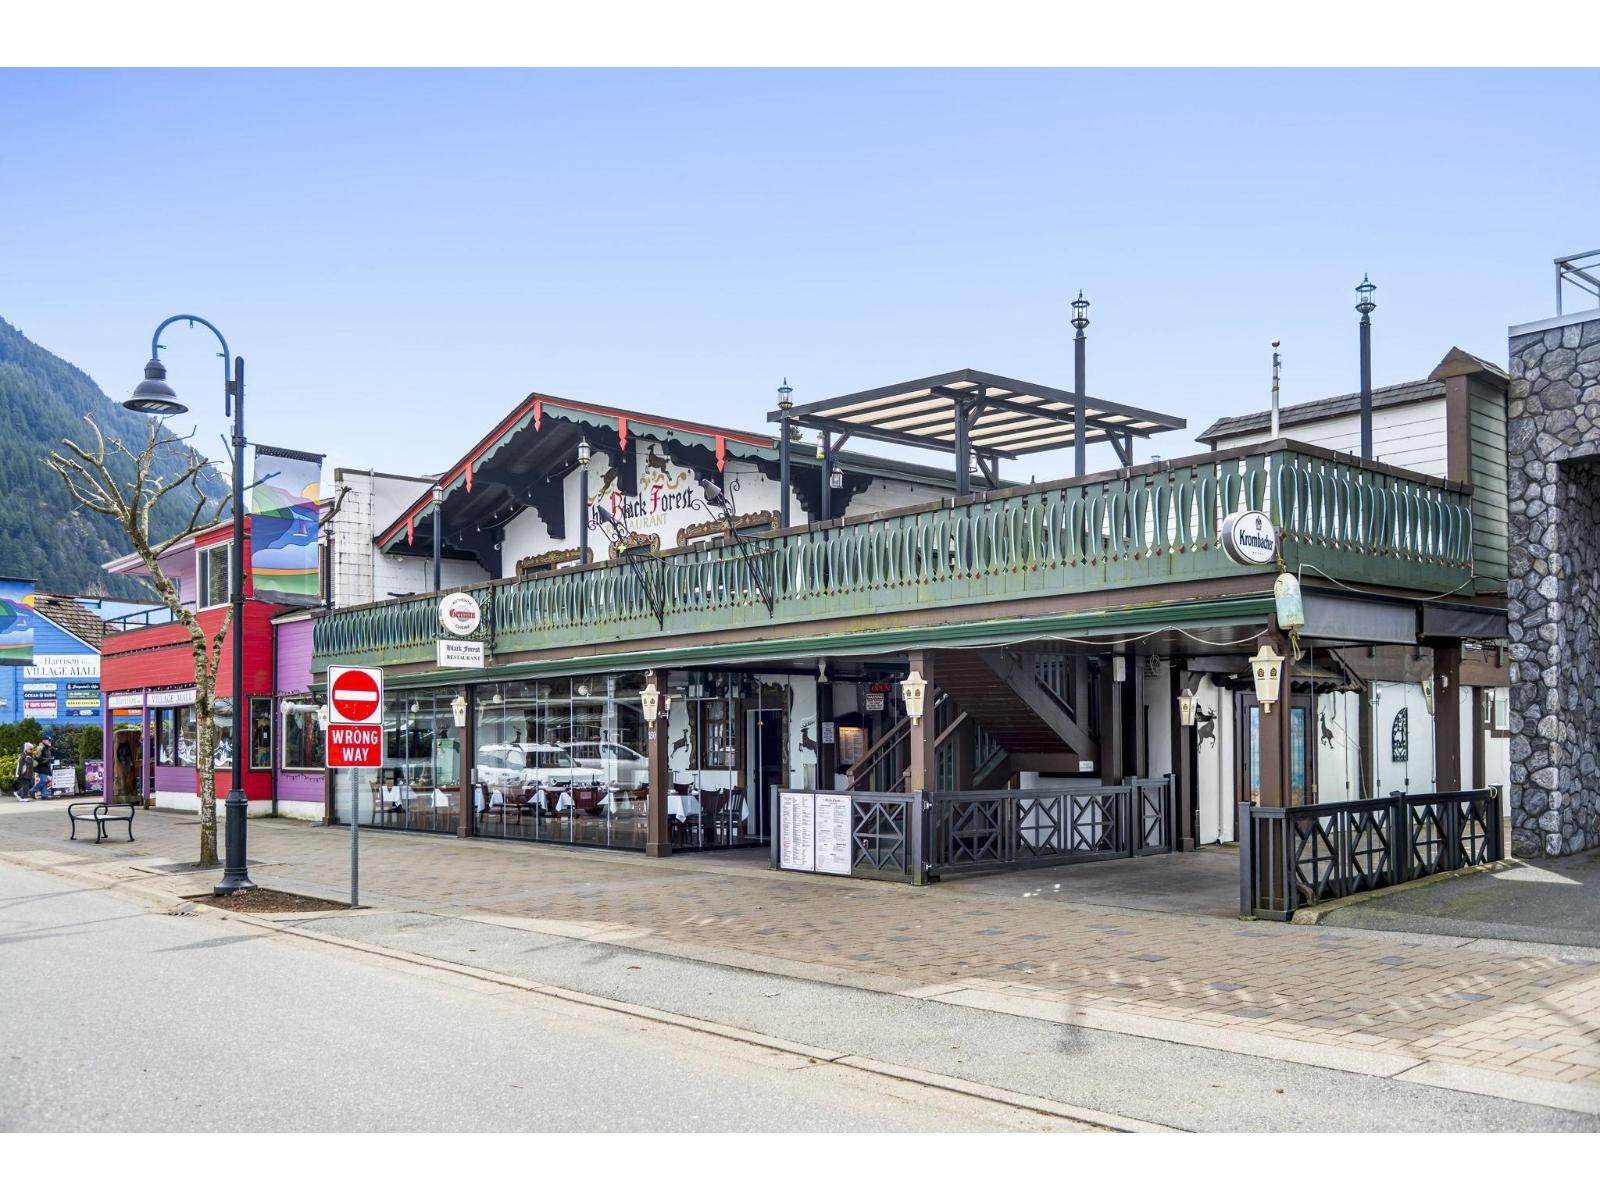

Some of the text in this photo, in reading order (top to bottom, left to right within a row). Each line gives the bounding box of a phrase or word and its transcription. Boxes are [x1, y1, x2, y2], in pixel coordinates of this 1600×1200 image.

[649, 484, 694, 514] Forest
[1239, 529, 1274, 551] Krombacher
[450, 609, 475, 618] German
[446, 644, 481, 653] Black Forest
[44, 656, 79, 665] Harrison
[26, 666, 98, 676] VILLAGE MALL
[871, 684, 891, 692] OPEN
[151, 694, 174, 703] VILLAGE
[332, 729, 378, 745] WRONG
[342, 747, 369, 762] WAY
